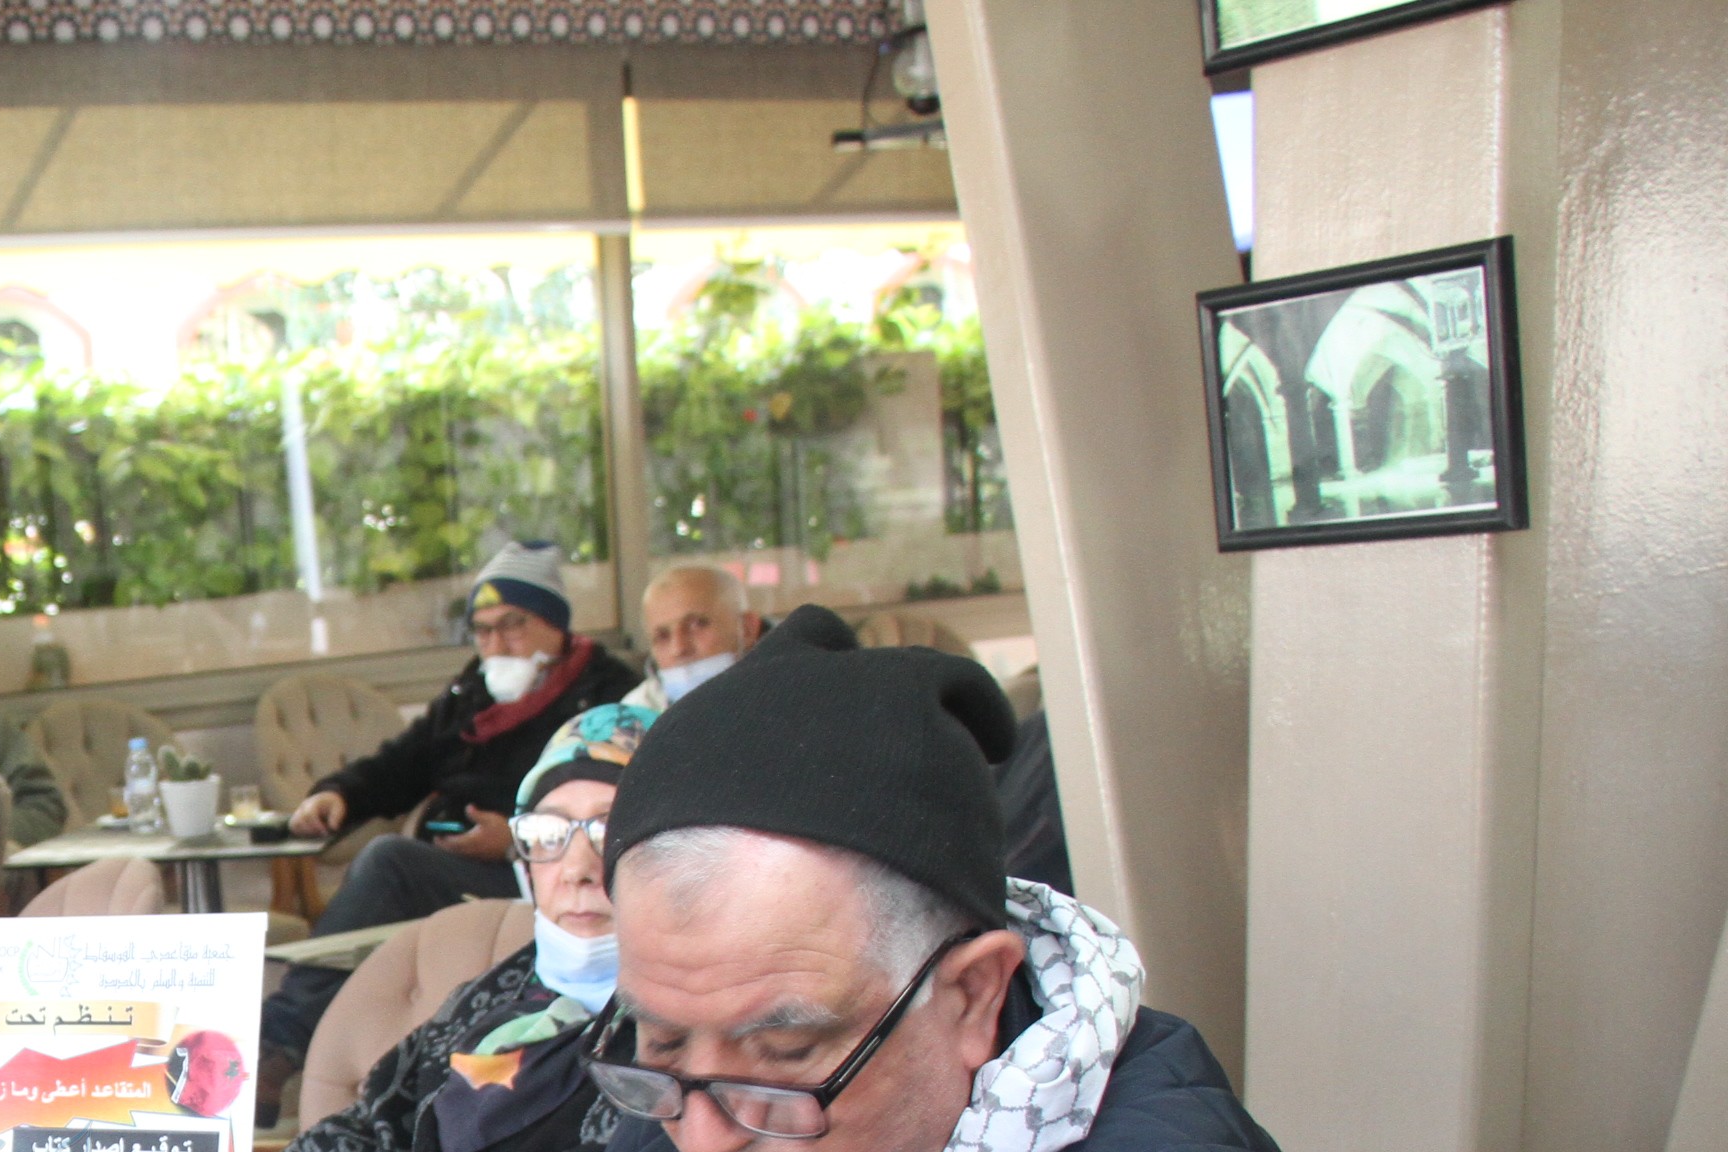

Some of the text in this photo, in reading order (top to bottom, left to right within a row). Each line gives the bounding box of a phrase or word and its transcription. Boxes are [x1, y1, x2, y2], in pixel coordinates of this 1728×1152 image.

[0, 945, 20, 957] OCP
[5, 1007, 46, 1026] تحت
[53, 1004, 133, 1036] تنظم
[40, 1078, 86, 1103] أعطى
[90, 1080, 151, 1098] المتقاعد
